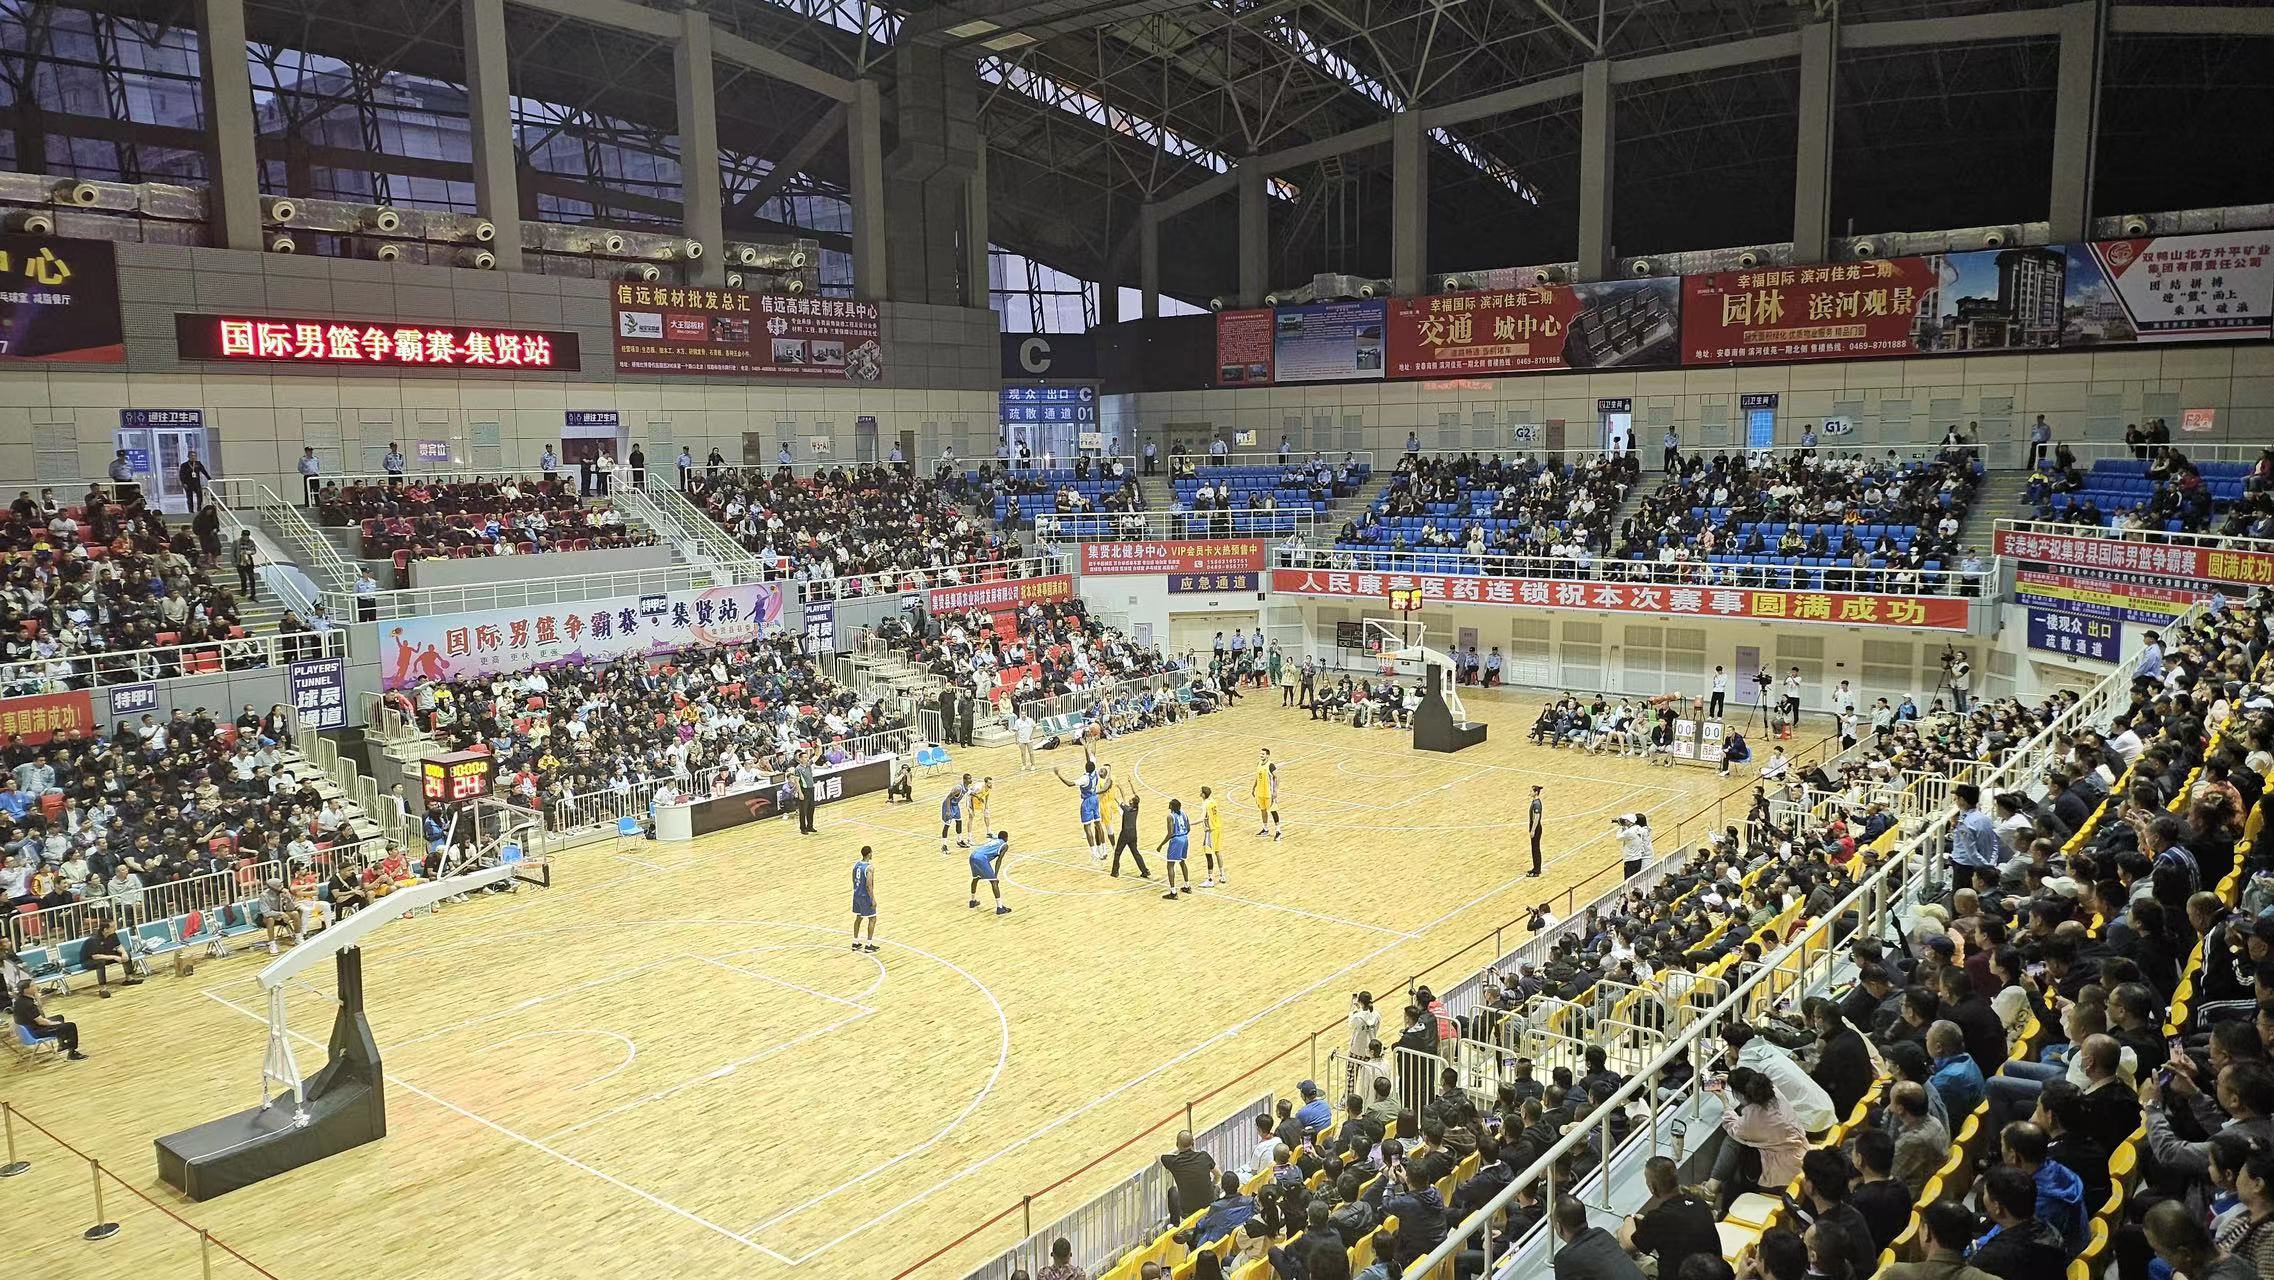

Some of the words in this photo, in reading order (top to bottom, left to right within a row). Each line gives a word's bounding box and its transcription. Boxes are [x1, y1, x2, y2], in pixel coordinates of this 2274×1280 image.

[2142, 244, 2271, 263] 双鸭山北方升平矿业
[0, 247, 71, 285] 心
[2147, 256, 2262, 274] 集团有限责任公司
[1737, 271, 1795, 289] 幸福国际
[1800, 264, 1892, 284] 滨河佳苑二期
[617, 285, 751, 311] 信远板材批发总汇
[761, 295, 878, 319] 信远高端定制家具中心
[1430, 296, 1476, 313] 幸福国际
[1480, 291, 1553, 310] 滨河佳苑二期
[1722, 289, 1785, 327] 园林
[1808, 286, 1916, 320] 滨河观景
[2173, 302, 2249, 316] 乘风破浪
[1417, 312, 1473, 347] 交通
[1493, 314, 1562, 341] 城中心
[219, 319, 551, 366] 国际男篮争霸赛-集贤站
[1849, 340, 1907, 351] 0469-8701888
[1020, 337, 1051, 374] C
[1079, 387, 1092, 401] C
[148, 411, 200, 424] 通往卫生间
[1077, 407, 1094, 420] 01
[1088, 544, 1168, 559] 集贤北健身中心
[1171, 543, 1258, 557] VIP会员卡火热预售中
[2004, 535, 2197, 575] 安泰地产祝集贤县国际男篮争霸赛
[2207, 552, 2272, 582] 圆满成功
[1180, 575, 1247, 591] 应急通道
[641, 598, 667, 613] 特甲2
[806, 603, 832, 614] PLAYERS'
[806, 613, 828, 623] TUNNEL
[2035, 615, 2082, 635] 一楼观众
[2087, 620, 2112, 639] 出口
[2045, 634, 2103, 657] 疏散通道
[294, 663, 339, 676] PLAYERS'
[295, 675, 334, 689] TUNNEL
[114, 688, 154, 709] 特甲1
[297, 686, 341, 709] 球员
[0, 703, 81, 736] 事圆满成功!
[299, 705, 342, 727] 通道
